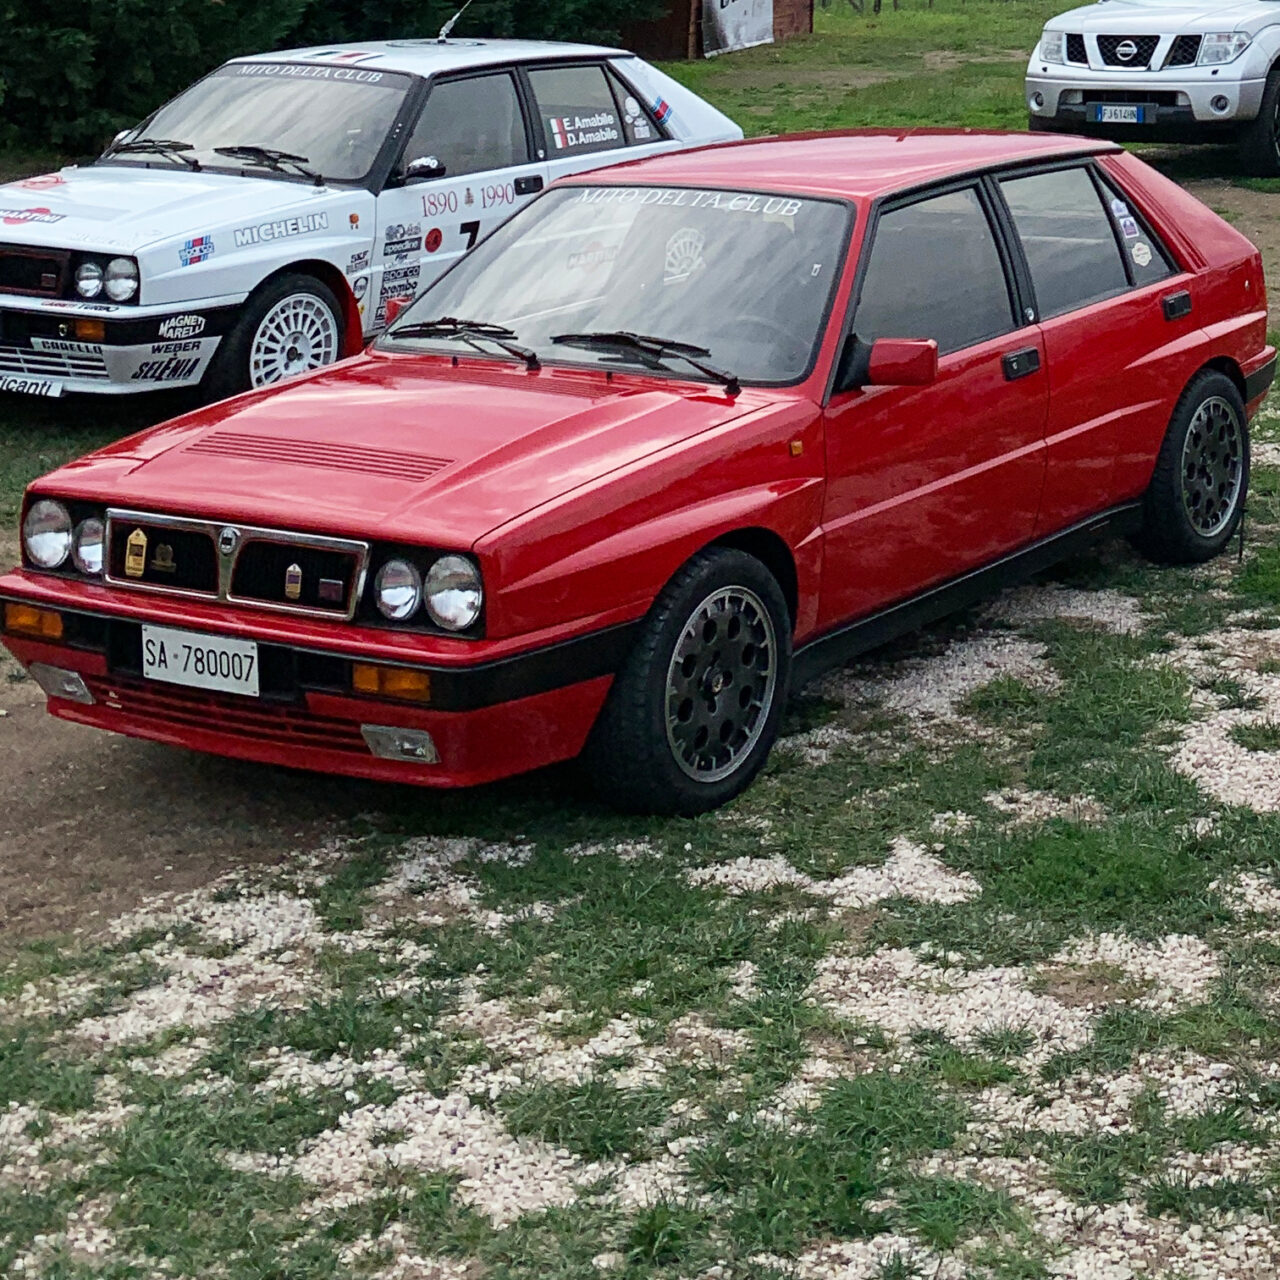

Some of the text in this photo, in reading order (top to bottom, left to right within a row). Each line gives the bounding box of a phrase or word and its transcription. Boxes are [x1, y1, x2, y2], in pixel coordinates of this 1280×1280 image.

[237, 64, 384, 83] MITO DELTA CLUB
[563, 113, 615, 131] E.Amabile
[566, 127, 619, 147] D.Amabile
[421, 182, 516, 218] 1890 1990
[575, 188, 803, 217] MITO DELTA CLUB
[234, 212, 329, 248] MICHELIN
[381, 279, 418, 296] brembo
[152, 341, 202, 354] WEBER
[132, 357, 201, 382] SELENIA
[0, 373, 52, 397] icanti
[145, 638, 255, 683] SA 780007
